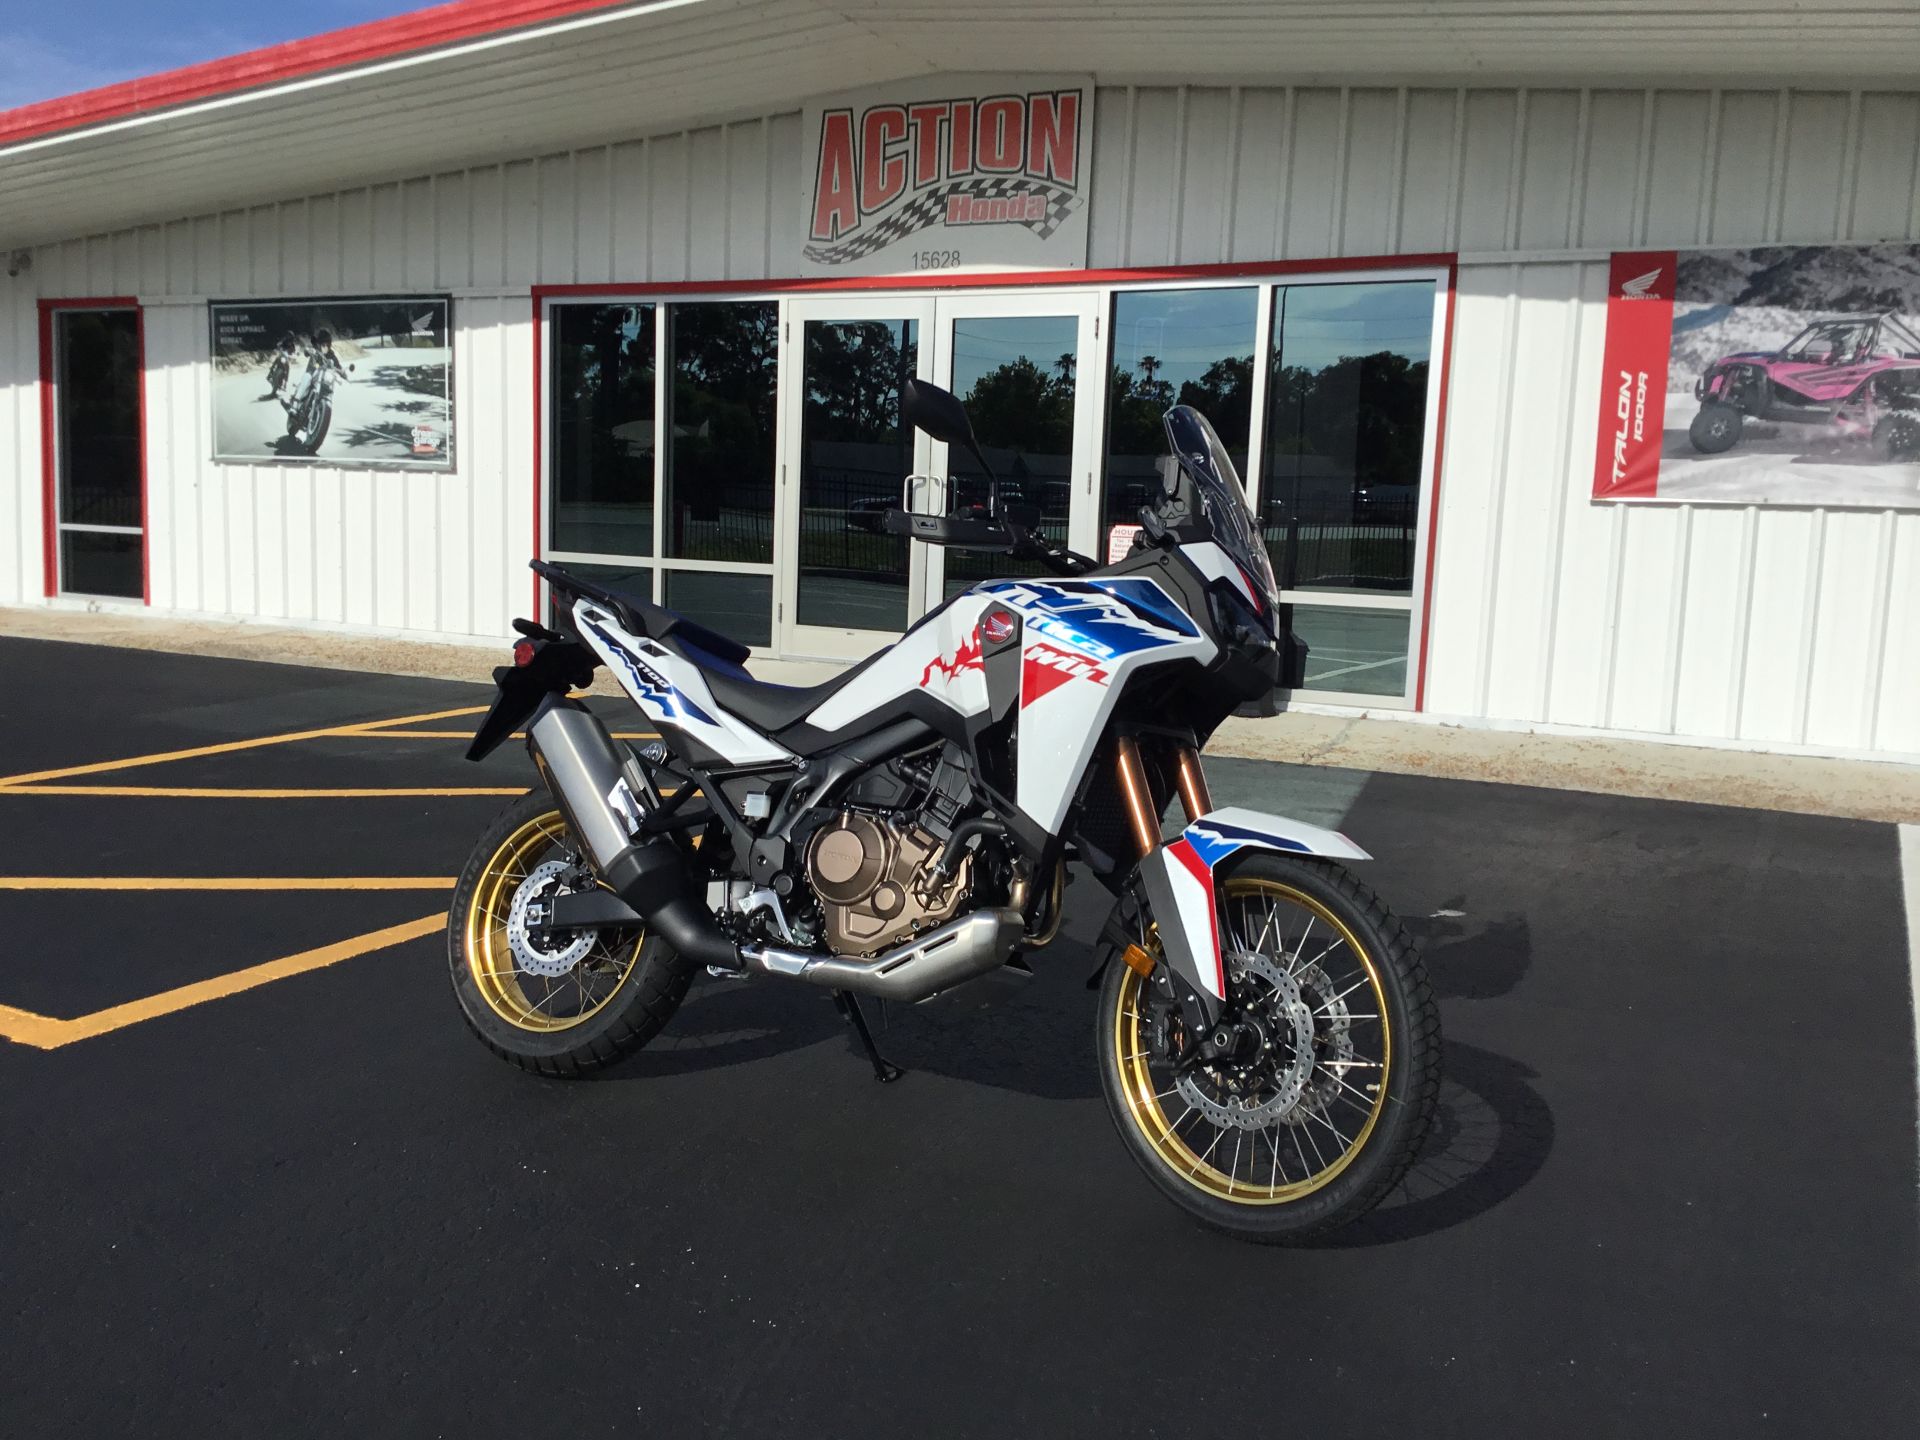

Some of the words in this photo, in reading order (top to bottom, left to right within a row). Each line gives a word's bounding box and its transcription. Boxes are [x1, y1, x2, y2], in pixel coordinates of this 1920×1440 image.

[808, 88, 1083, 242] ACTION
[945, 190, 1047, 225] Honda
[911, 250, 961, 270] 15628
[1612, 370, 1633, 484] TALON
[636, 661, 670, 688] 1100
